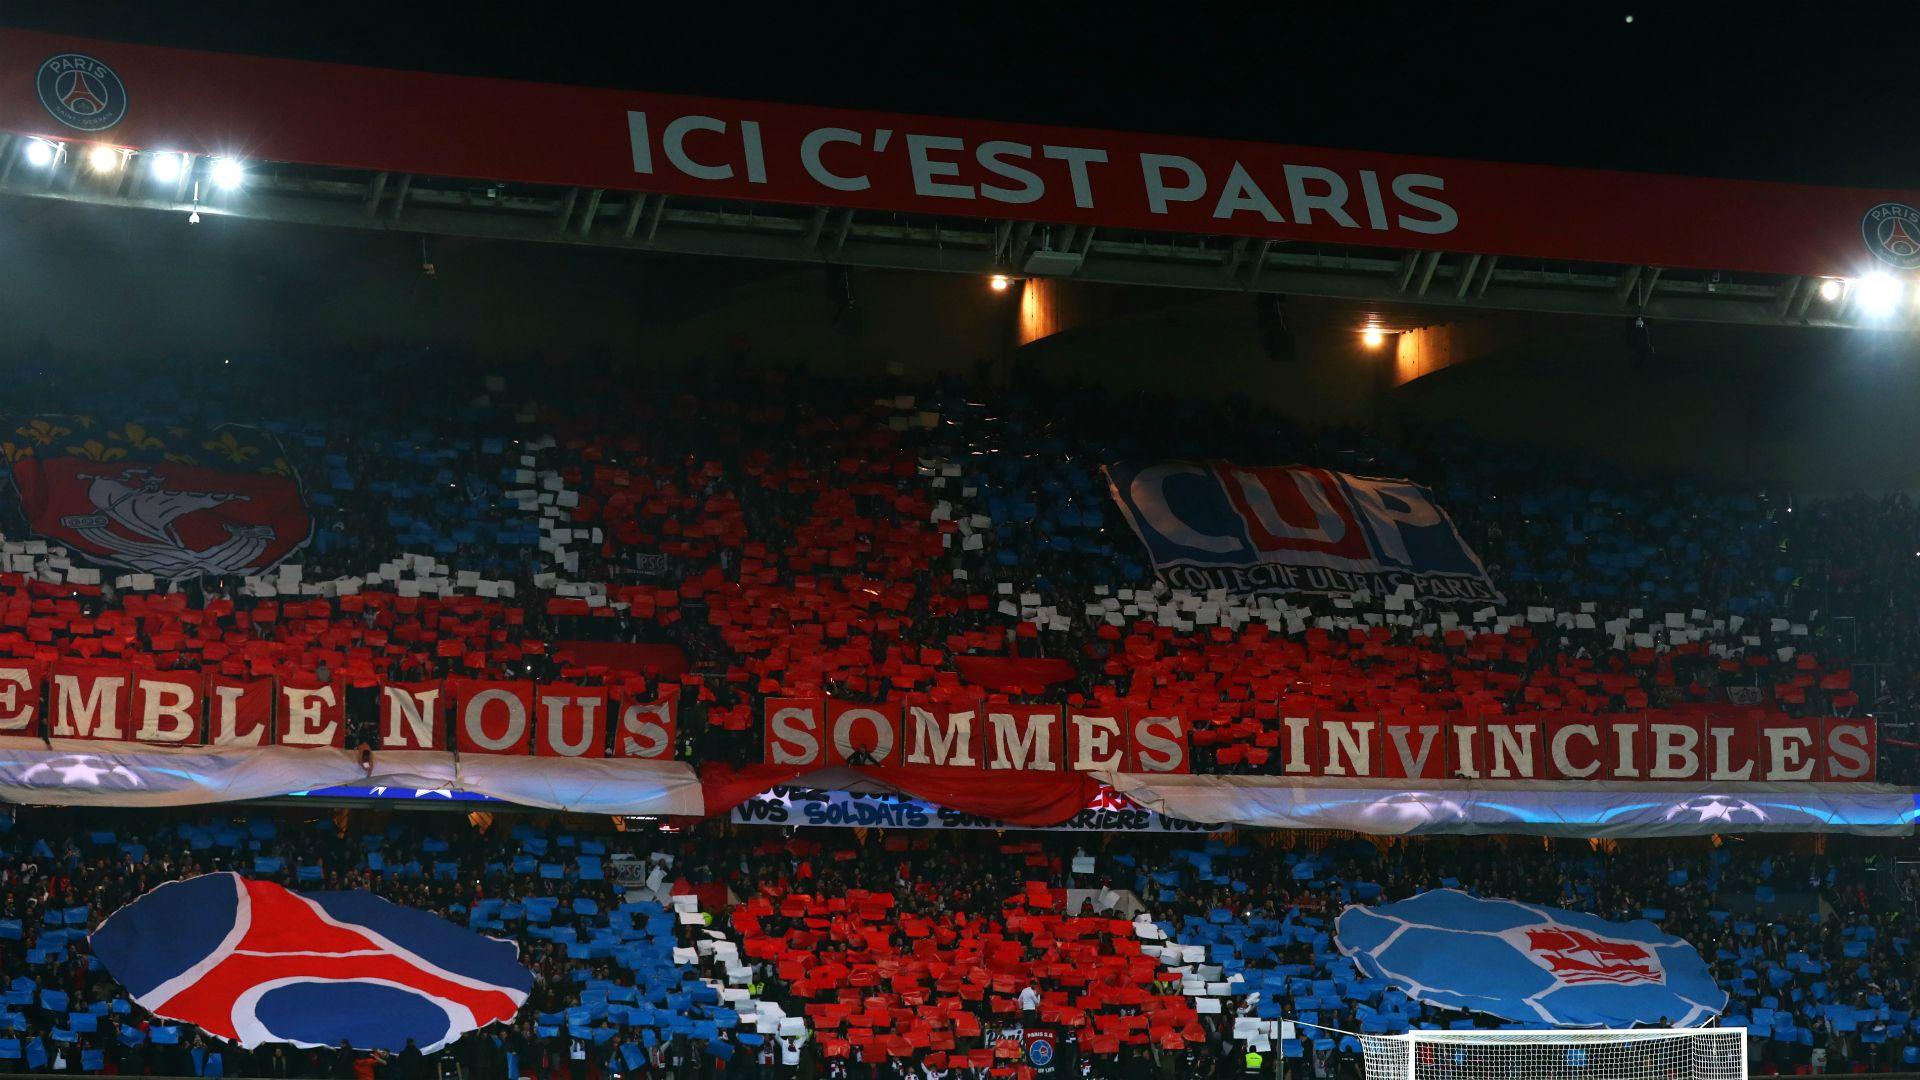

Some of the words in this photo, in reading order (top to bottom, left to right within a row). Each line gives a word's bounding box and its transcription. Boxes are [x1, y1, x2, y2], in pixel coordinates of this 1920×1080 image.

[49, 58, 107, 79] PARIS
[627, 110, 768, 184] ICI
[800, 127, 1109, 209] C'EST
[1140, 151, 1459, 235] PARIS
[1871, 206, 1920, 223] PARIS
[1131, 464, 1440, 566] CUP
[1168, 564, 1299, 593] COLLECTIF
[1412, 575, 1492, 599] PARIS
[383, 686, 671, 757] NOUS
[771, 706, 1183, 773] SOMMES
[1284, 717, 1870, 781] INVINCIBLES
[738, 799, 789, 823] VOS
[803, 801, 929, 828] SOLDATS
